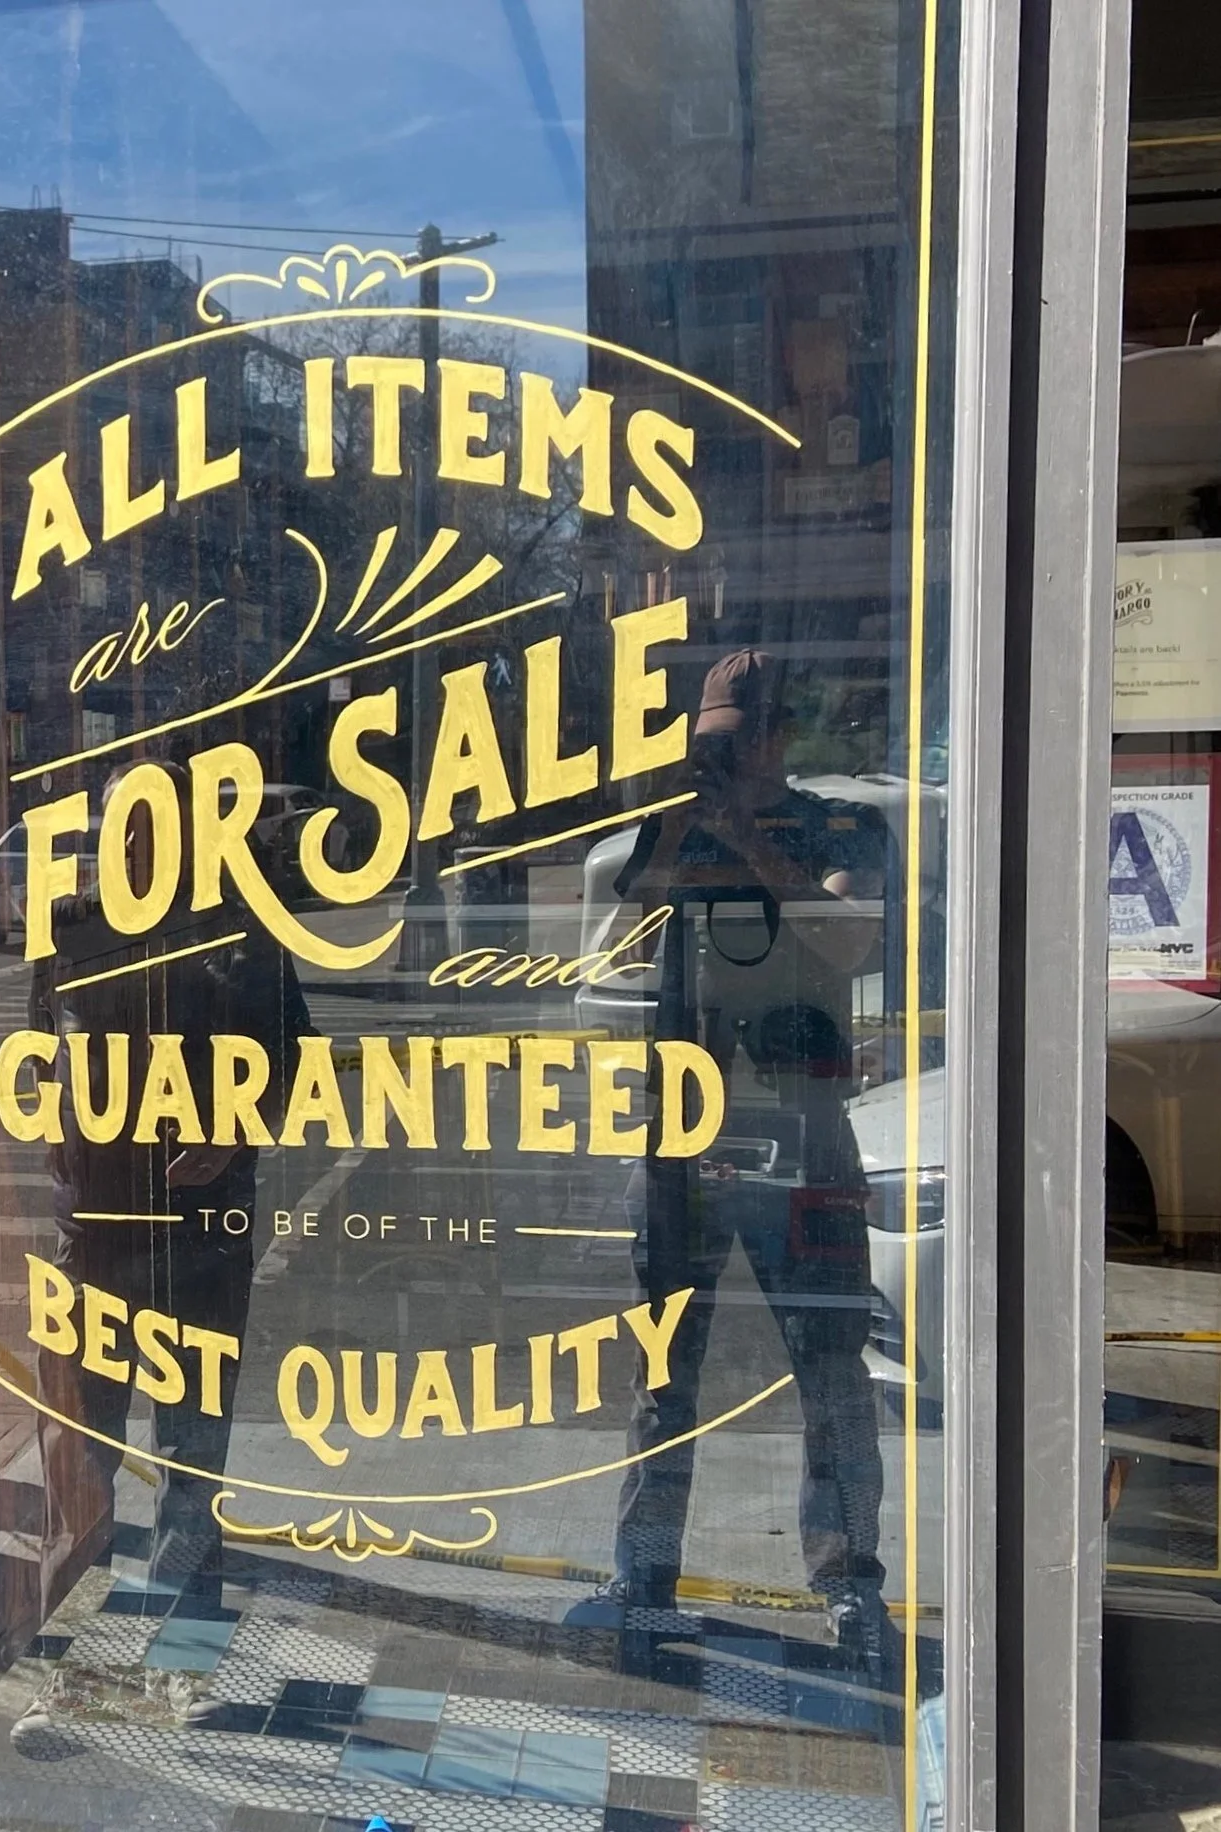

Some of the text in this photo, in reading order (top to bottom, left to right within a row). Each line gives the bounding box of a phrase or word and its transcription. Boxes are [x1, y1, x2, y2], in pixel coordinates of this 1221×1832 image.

[12, 356, 704, 600] ALL ITEMS
[69, 598, 225, 692] are
[22, 597, 689, 970] FOR SALE
[1161, 791, 1194, 801] GRADE
[1109, 811, 1181, 927] A
[428, 905, 674, 988] and
[1160, 943, 1194, 955] NYC
[198, 1207, 497, 1244] TO BE OF THE
[25, 1252, 240, 1417] BEST
[277, 1287, 696, 1466] QUALITY
